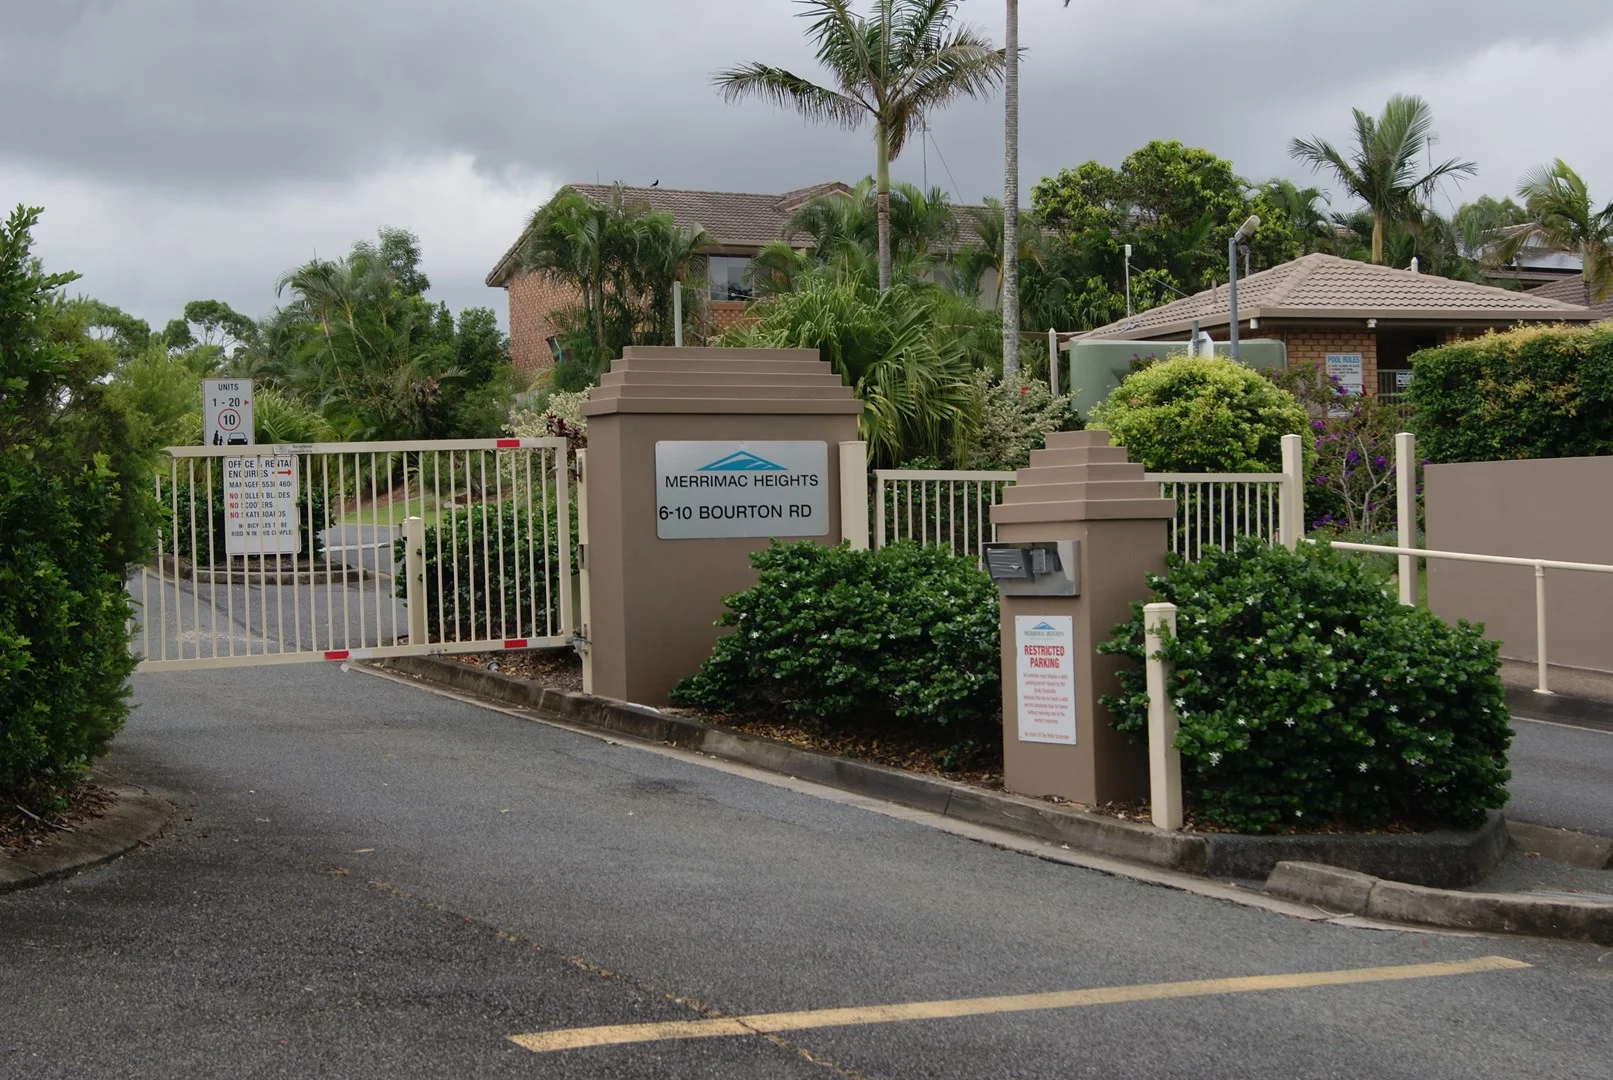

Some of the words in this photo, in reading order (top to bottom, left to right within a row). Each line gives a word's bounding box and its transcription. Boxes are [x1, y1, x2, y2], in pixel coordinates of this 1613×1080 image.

[213, 398, 216, 407] 1
[229, 398, 240, 407] 20
[223, 414, 235, 425] 10
[665, 475, 748, 488] MERRIMAC
[754, 474, 818, 487] HEIGHTS
[659, 506, 692, 520] 6-10
[699, 505, 782, 519] BOURTON
[789, 504, 811, 518] RD
[1024, 645, 1064, 656] RESTRICTED
[1030, 658, 1060, 668] PARKING
